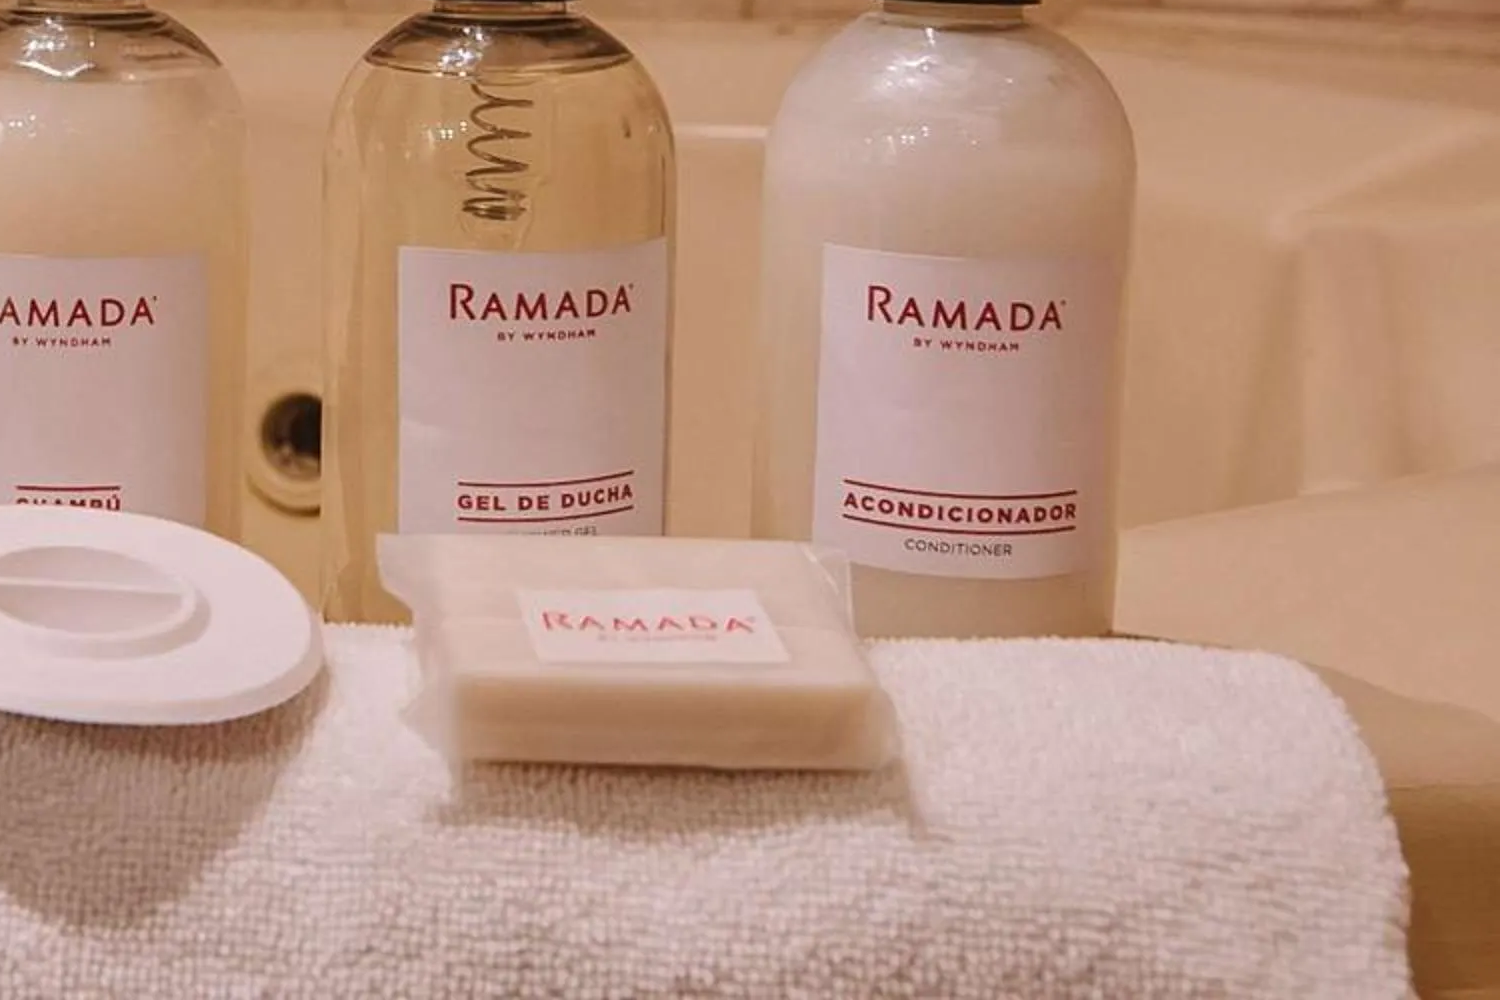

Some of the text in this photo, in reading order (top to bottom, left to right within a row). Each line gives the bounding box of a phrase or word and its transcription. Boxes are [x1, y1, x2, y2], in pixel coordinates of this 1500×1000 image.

[449, 283, 632, 321] RAMADA
[867, 285, 1063, 332] RAMADA
[12, 336, 112, 348] BY WYNDHAM
[497, 328, 597, 341] BY WYNDHAM
[913, 337, 1020, 352] BY WYNDHAM
[457, 484, 633, 512] GEL DE DUCHA
[843, 491, 1077, 524] ACONDICIONADOR
[904, 538, 1013, 556] CONDITIONER
[541, 611, 755, 633] RAMADA
